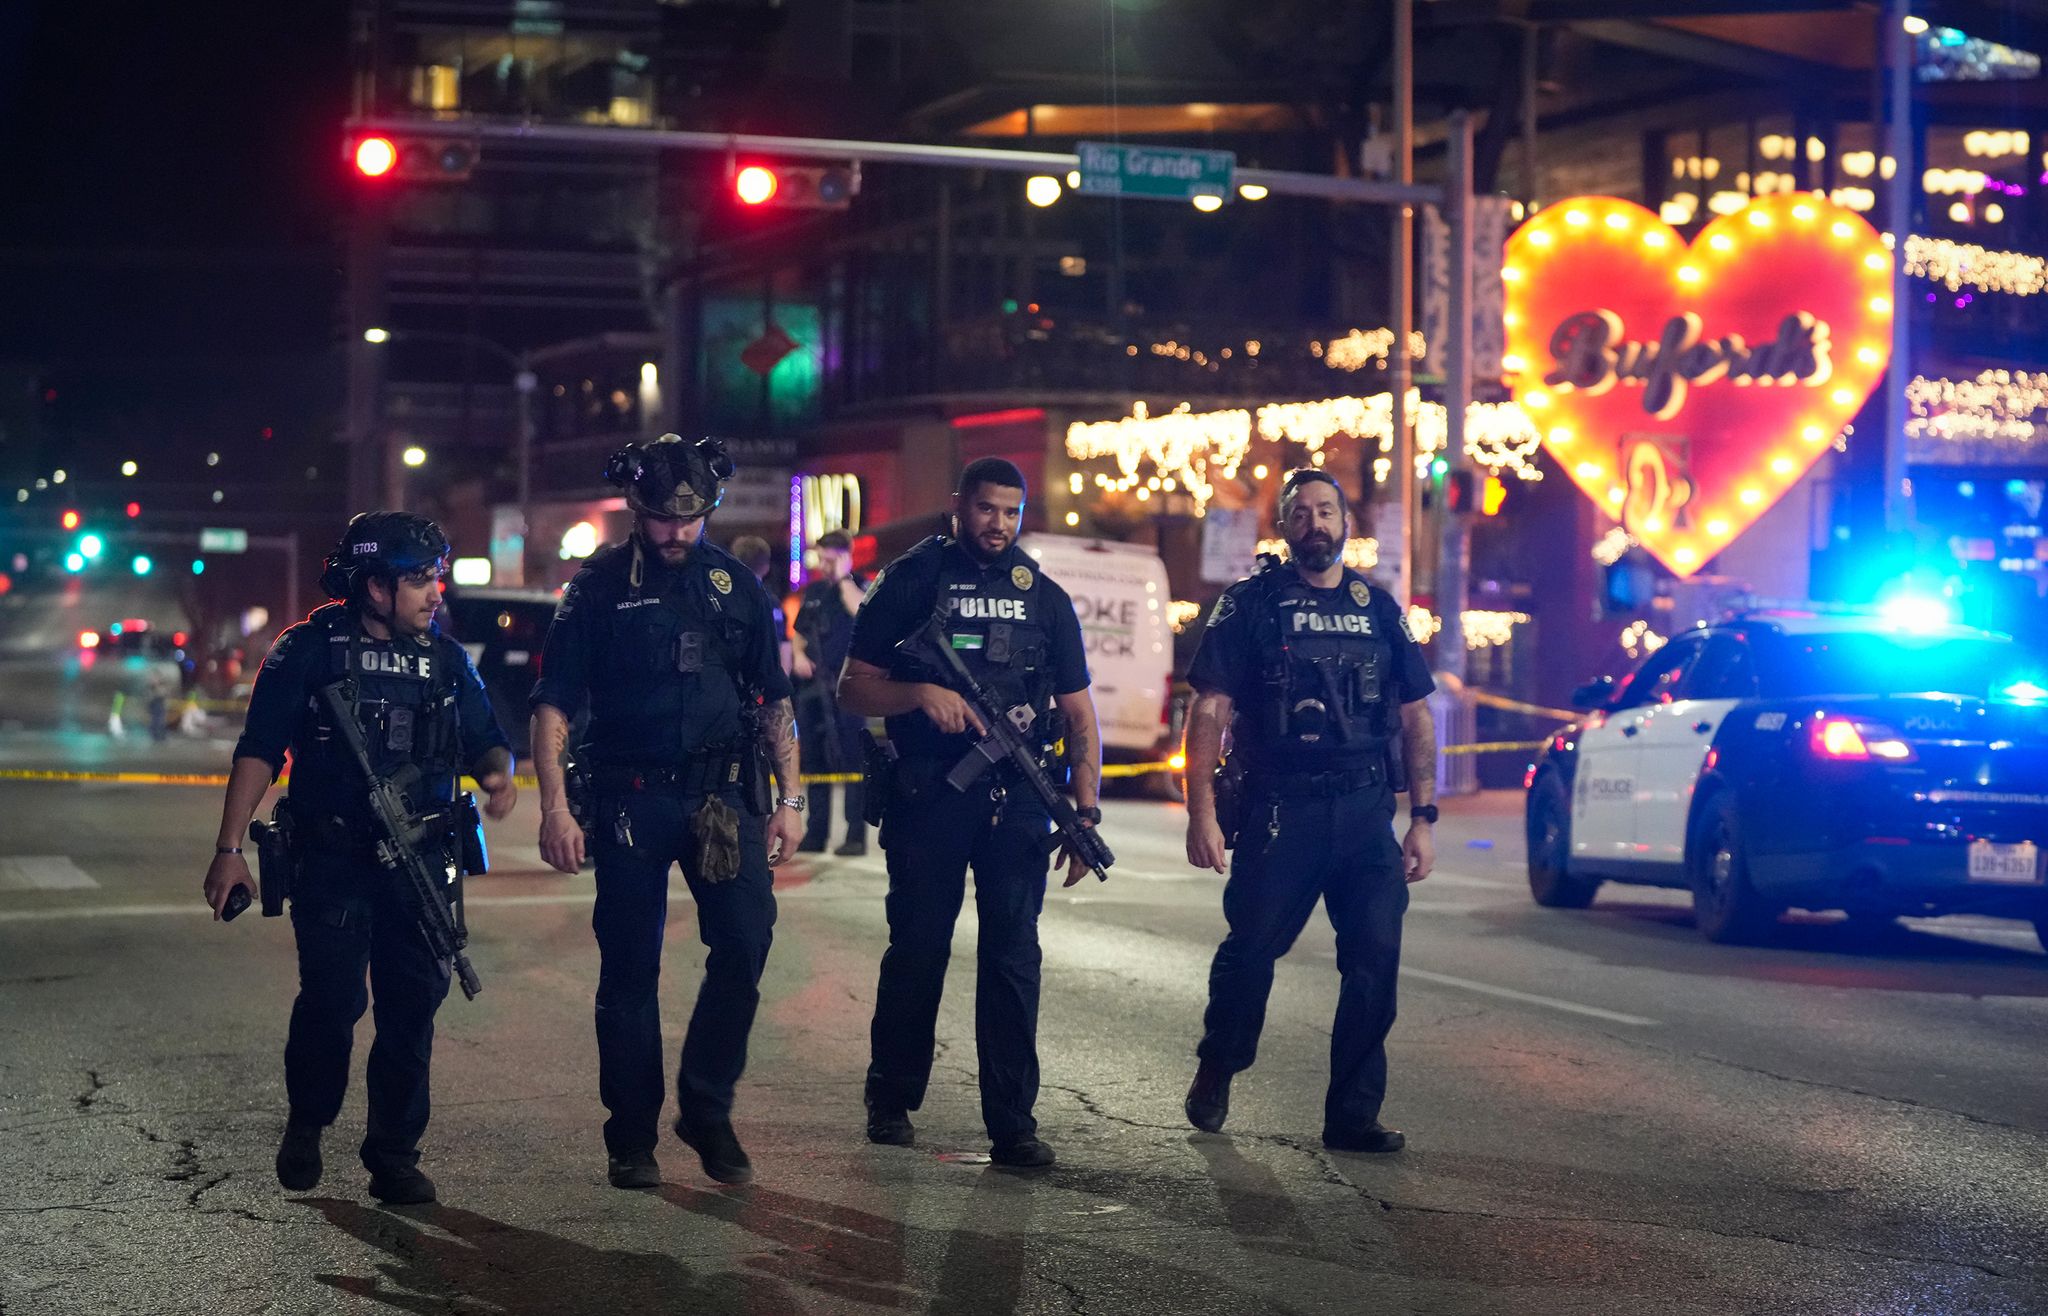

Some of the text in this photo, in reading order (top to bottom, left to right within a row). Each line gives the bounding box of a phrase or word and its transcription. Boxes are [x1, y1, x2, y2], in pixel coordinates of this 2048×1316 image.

[1085, 147, 1119, 173] Rio
[1125, 149, 1202, 179] Grande
[353, 542, 378, 555] E703
[948, 597, 1027, 620] POLICE
[1072, 596, 1137, 625] OKE
[1293, 612, 1372, 635] POLICE
[1086, 635, 1136, 659] UCK
[1904, 715, 1966, 731] POLIC
[1592, 778, 1632, 794] POLICE
